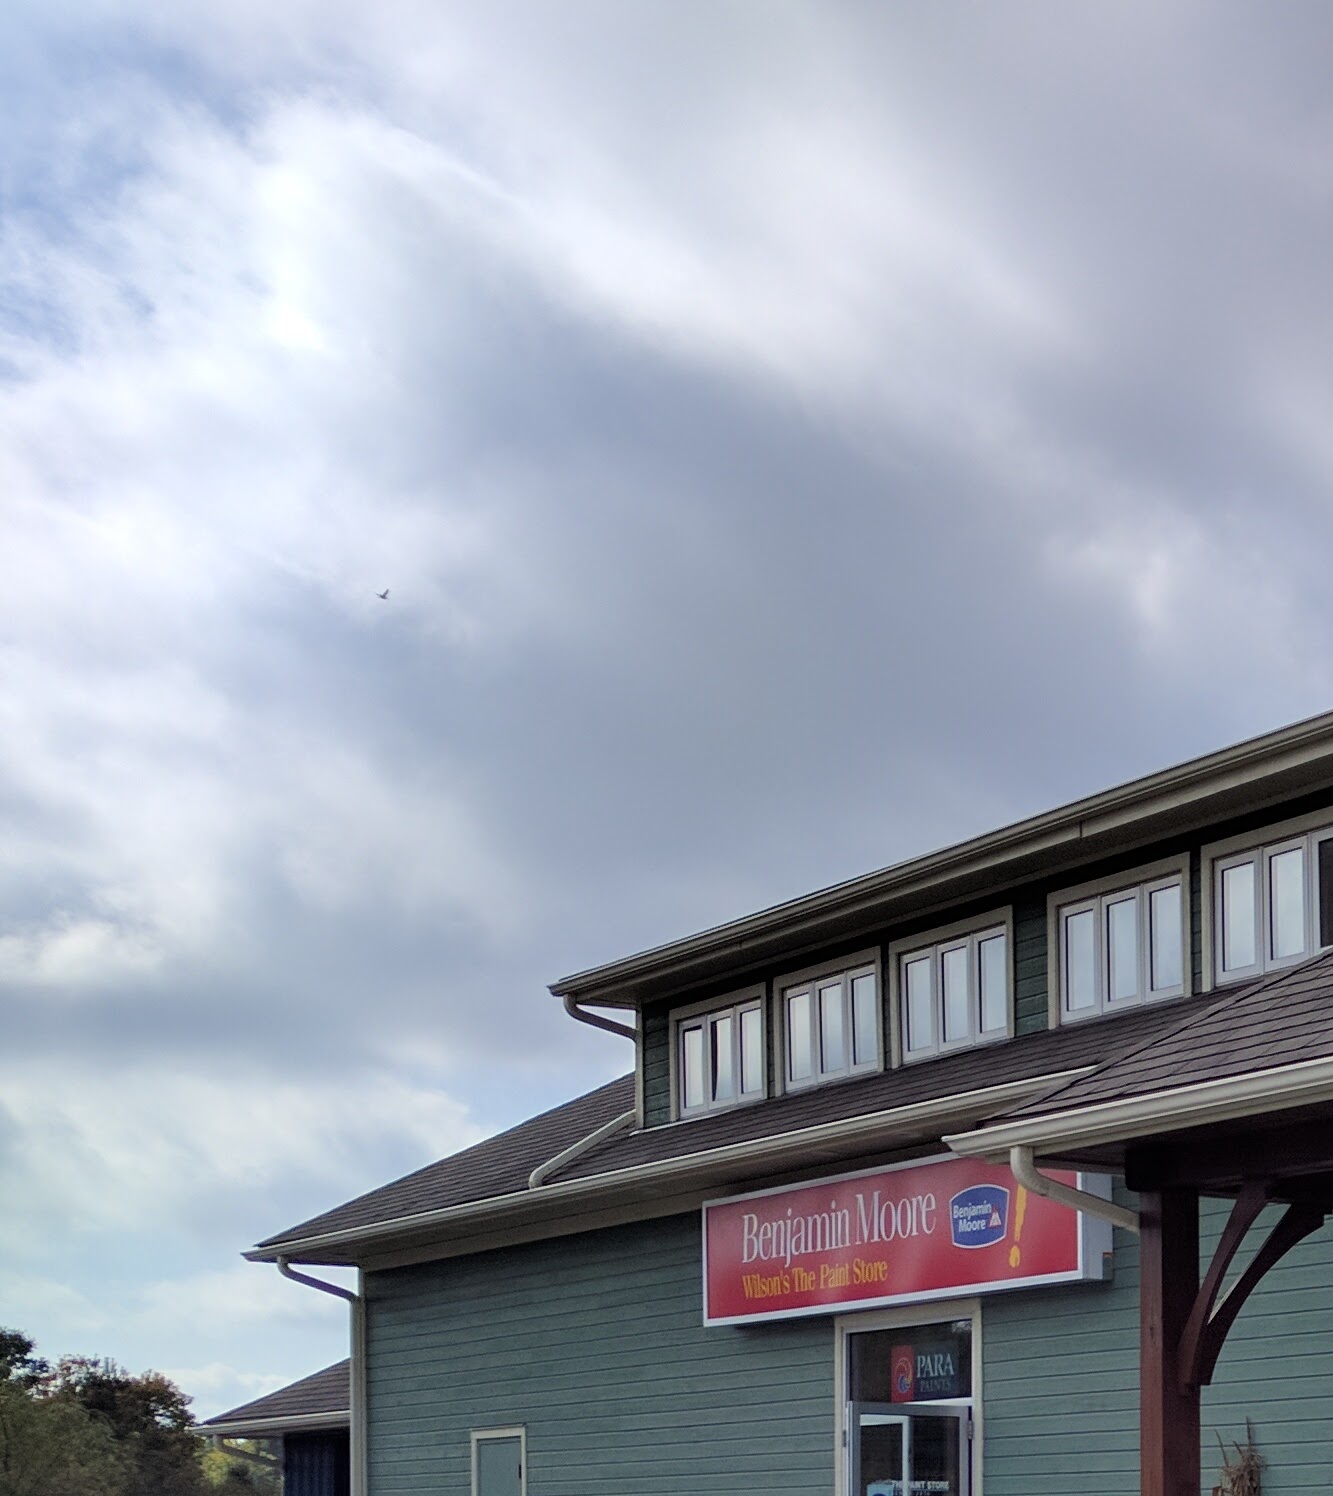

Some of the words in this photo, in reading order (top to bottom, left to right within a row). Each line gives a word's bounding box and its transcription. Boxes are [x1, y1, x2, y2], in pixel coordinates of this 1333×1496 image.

[952, 1200, 993, 1220] Benjamin
[742, 1200, 851, 1268] Benjamin
[855, 1190, 937, 1246] Moore
[958, 1219, 987, 1233] Moore
[742, 1270, 791, 1299] Wilson's
[792, 1267, 816, 1293] The
[820, 1263, 850, 1289] Paint
[853, 1257, 888, 1284] Store
[917, 1353, 955, 1378] PARA
